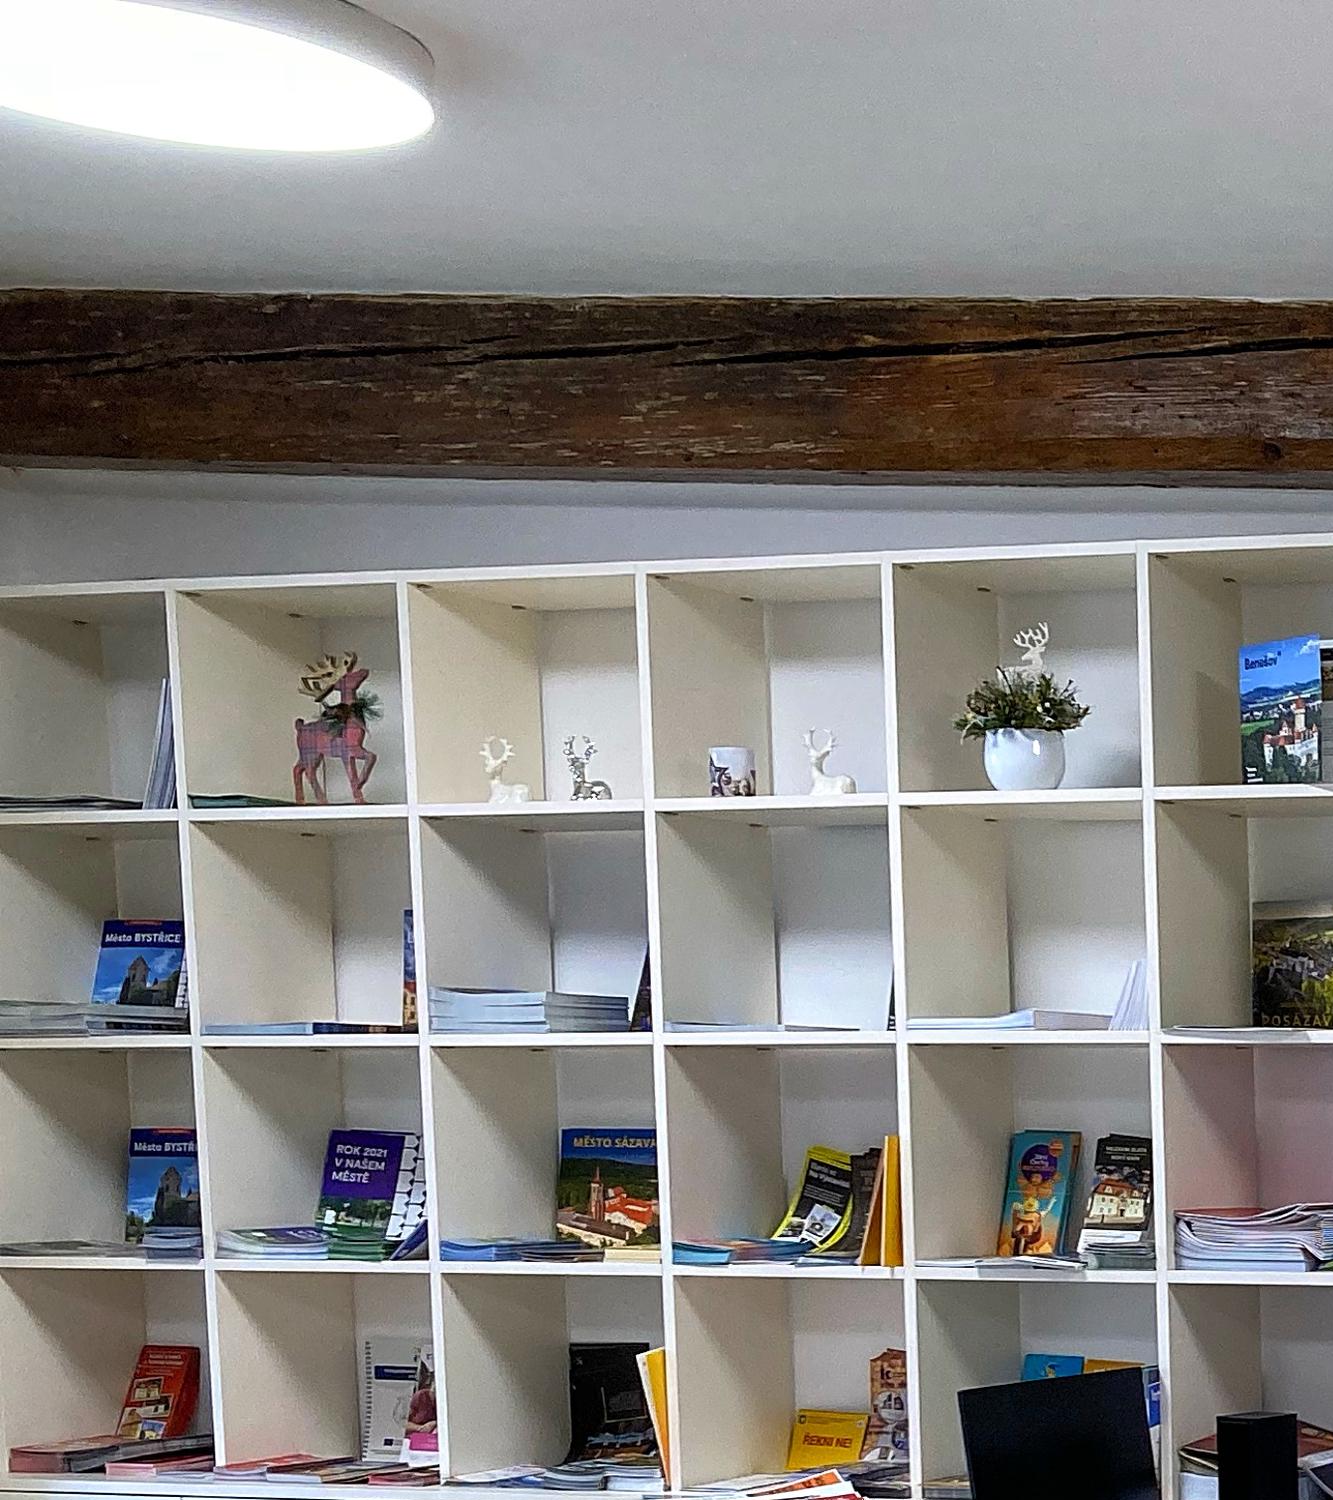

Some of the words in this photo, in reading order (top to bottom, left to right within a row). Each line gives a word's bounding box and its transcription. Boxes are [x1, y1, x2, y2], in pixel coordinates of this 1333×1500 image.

[105, 932, 132, 943] Město
[134, 930, 182, 944] BYSTŘICE
[164, 1140, 198, 1153] BYSTŘ
[573, 1134, 612, 1148] MĚSTO
[336, 1144, 361, 1156] ROK
[362, 1147, 388, 1158] 2021
[334, 1157, 343, 1168] V
[345, 1158, 385, 1171] NAŠEM
[331, 1170, 370, 1183] MĚSTĚ
